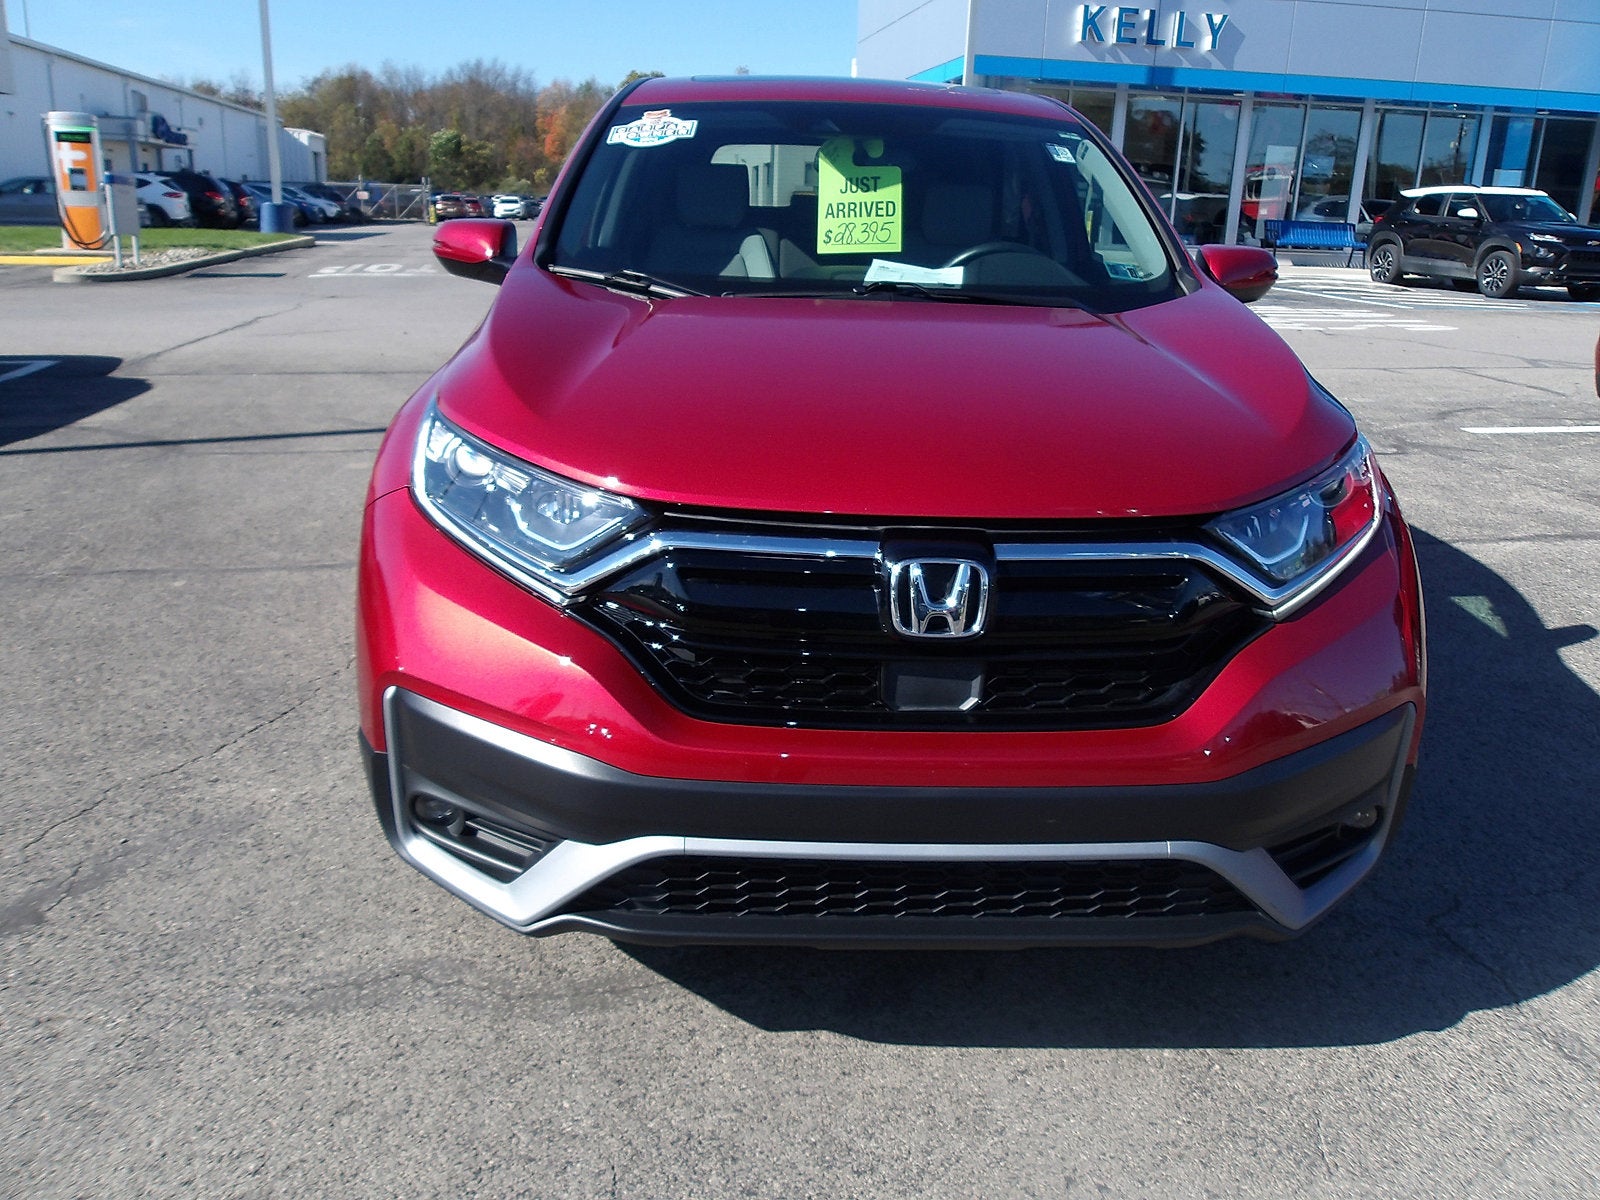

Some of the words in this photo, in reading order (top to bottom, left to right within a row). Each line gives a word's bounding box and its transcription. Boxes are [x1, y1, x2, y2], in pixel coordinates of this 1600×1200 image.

[1080, 4, 1229, 50] KELLY
[840, 176, 881, 194] JUST
[825, 200, 896, 219] ARRIVED
